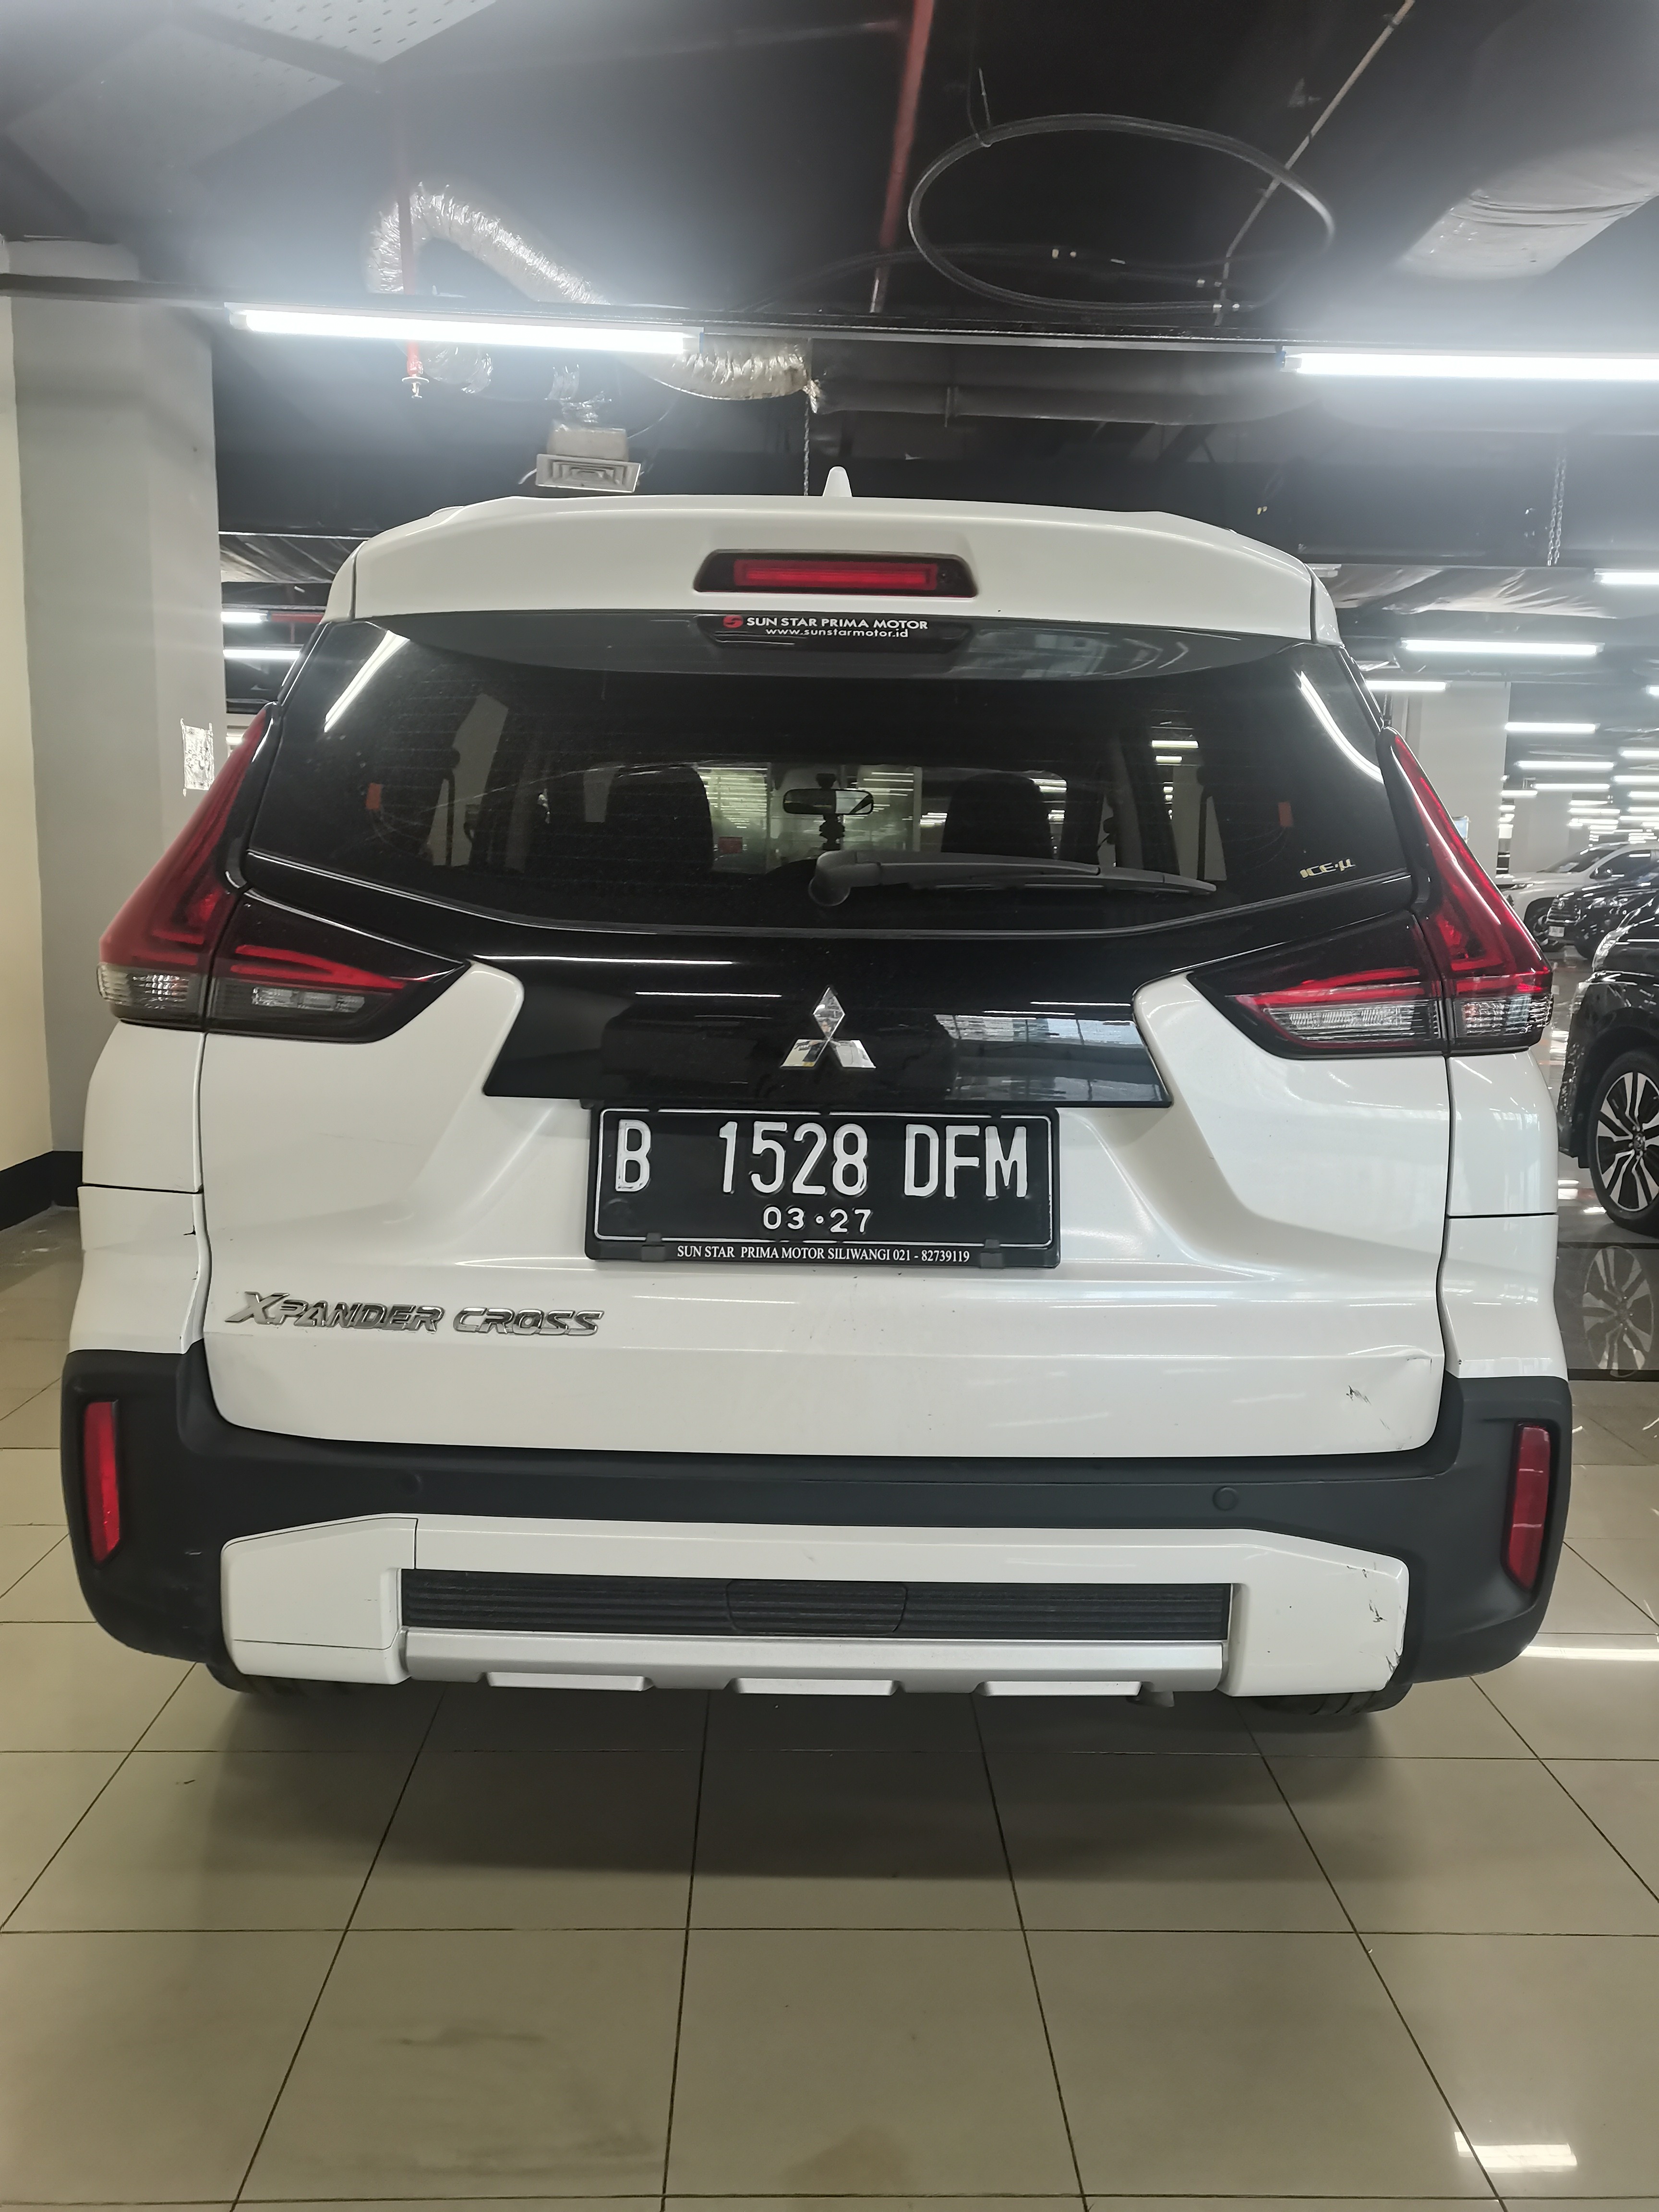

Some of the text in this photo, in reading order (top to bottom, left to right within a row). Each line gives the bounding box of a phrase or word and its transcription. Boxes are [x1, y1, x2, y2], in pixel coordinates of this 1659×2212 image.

[746, 617, 928, 630] SUN STAR PRIMA MOTOR
[765, 628, 908, 638] www.sunstarmotor.id
[615, 1119, 1027, 1198] B 1528 DFM
[677, 1245, 702, 1257] SUN
[705, 1246, 735, 1258] STAR
[741, 1247, 780, 1259] PRIMA
[781, 1247, 825, 1260] MOTOR
[828, 1248, 890, 1260] SILIWANGI
[892, 1249, 911, 1261] 021
[921, 1250, 970, 1262] 82739119
[225, 1291, 605, 1336] XPANDER CROSS
